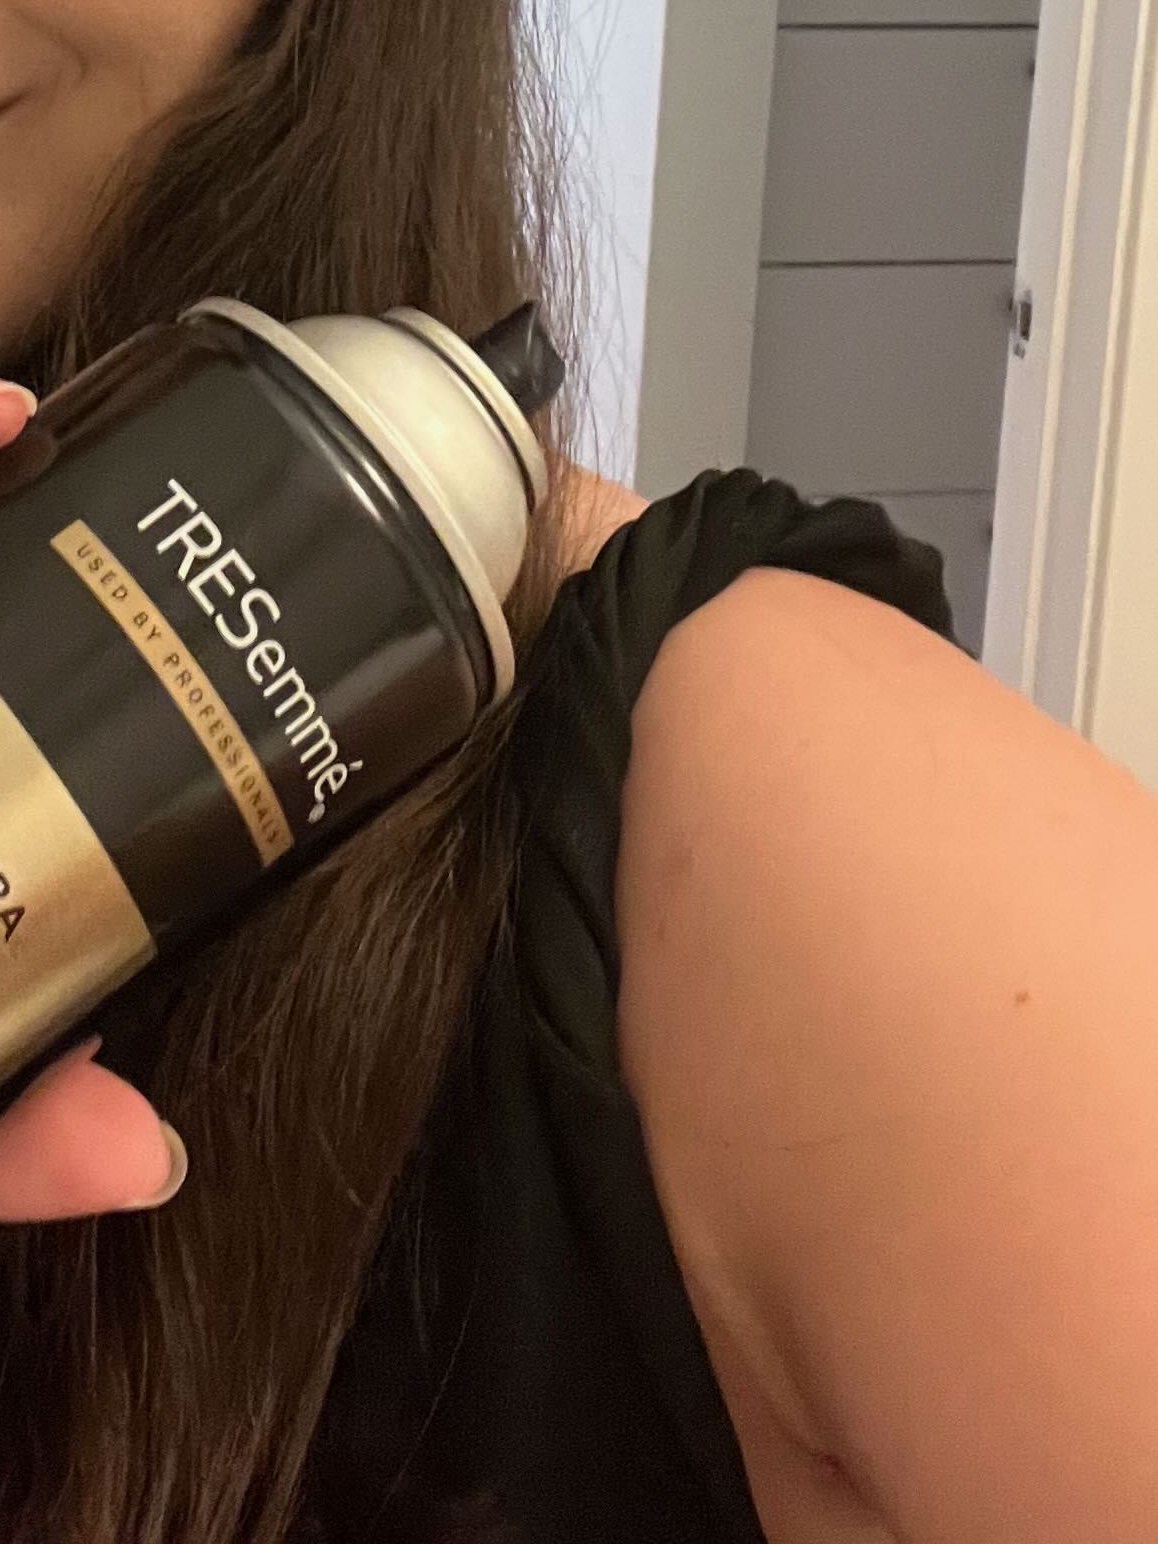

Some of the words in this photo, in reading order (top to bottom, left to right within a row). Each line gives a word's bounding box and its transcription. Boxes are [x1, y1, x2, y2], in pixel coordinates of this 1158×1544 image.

[76, 542, 129, 602] USED
[133, 610, 163, 642] BY
[163, 652, 280, 844] PROFESSIONALS
[137, 478, 364, 808] TRESemmé
